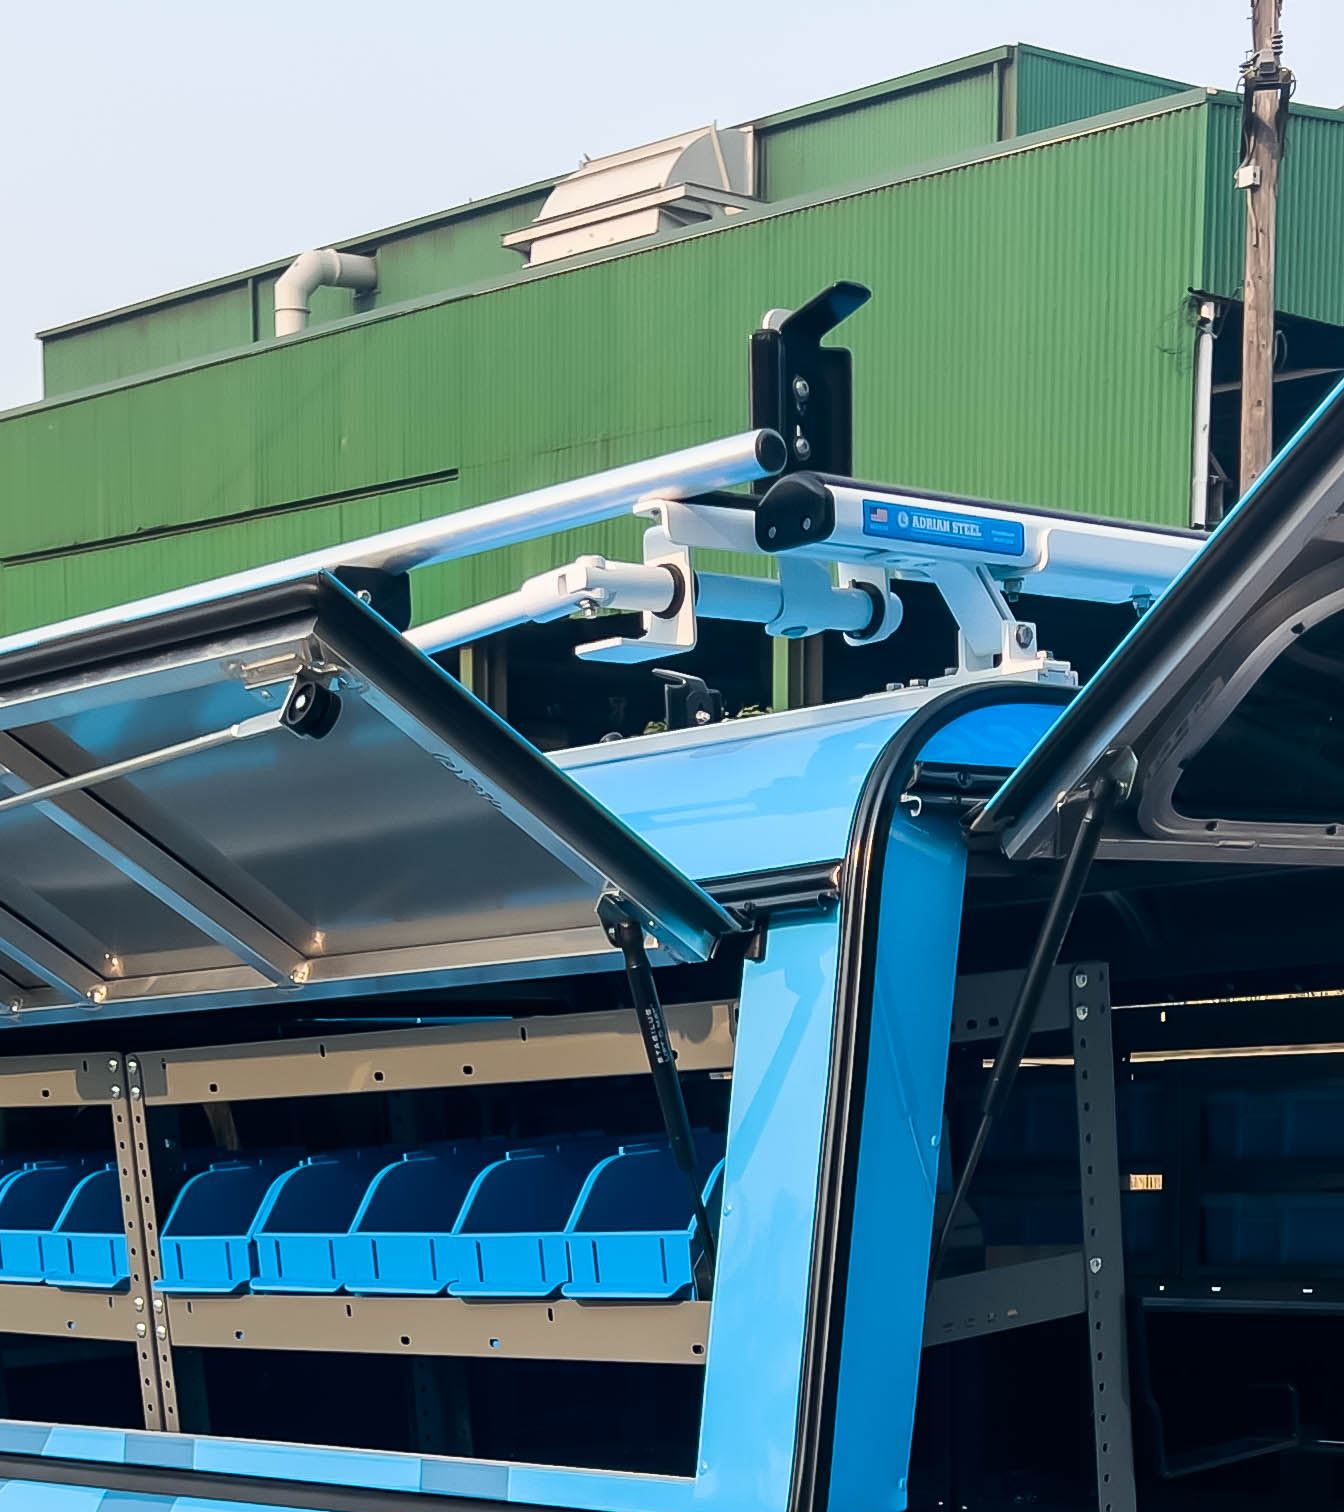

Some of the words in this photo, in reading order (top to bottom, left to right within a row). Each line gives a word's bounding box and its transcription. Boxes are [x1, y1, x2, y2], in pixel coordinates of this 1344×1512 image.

[912, 515, 950, 533] ADRIAN
[953, 522, 982, 537] STEEL
[645, 1008, 664, 1064] STABILUS
